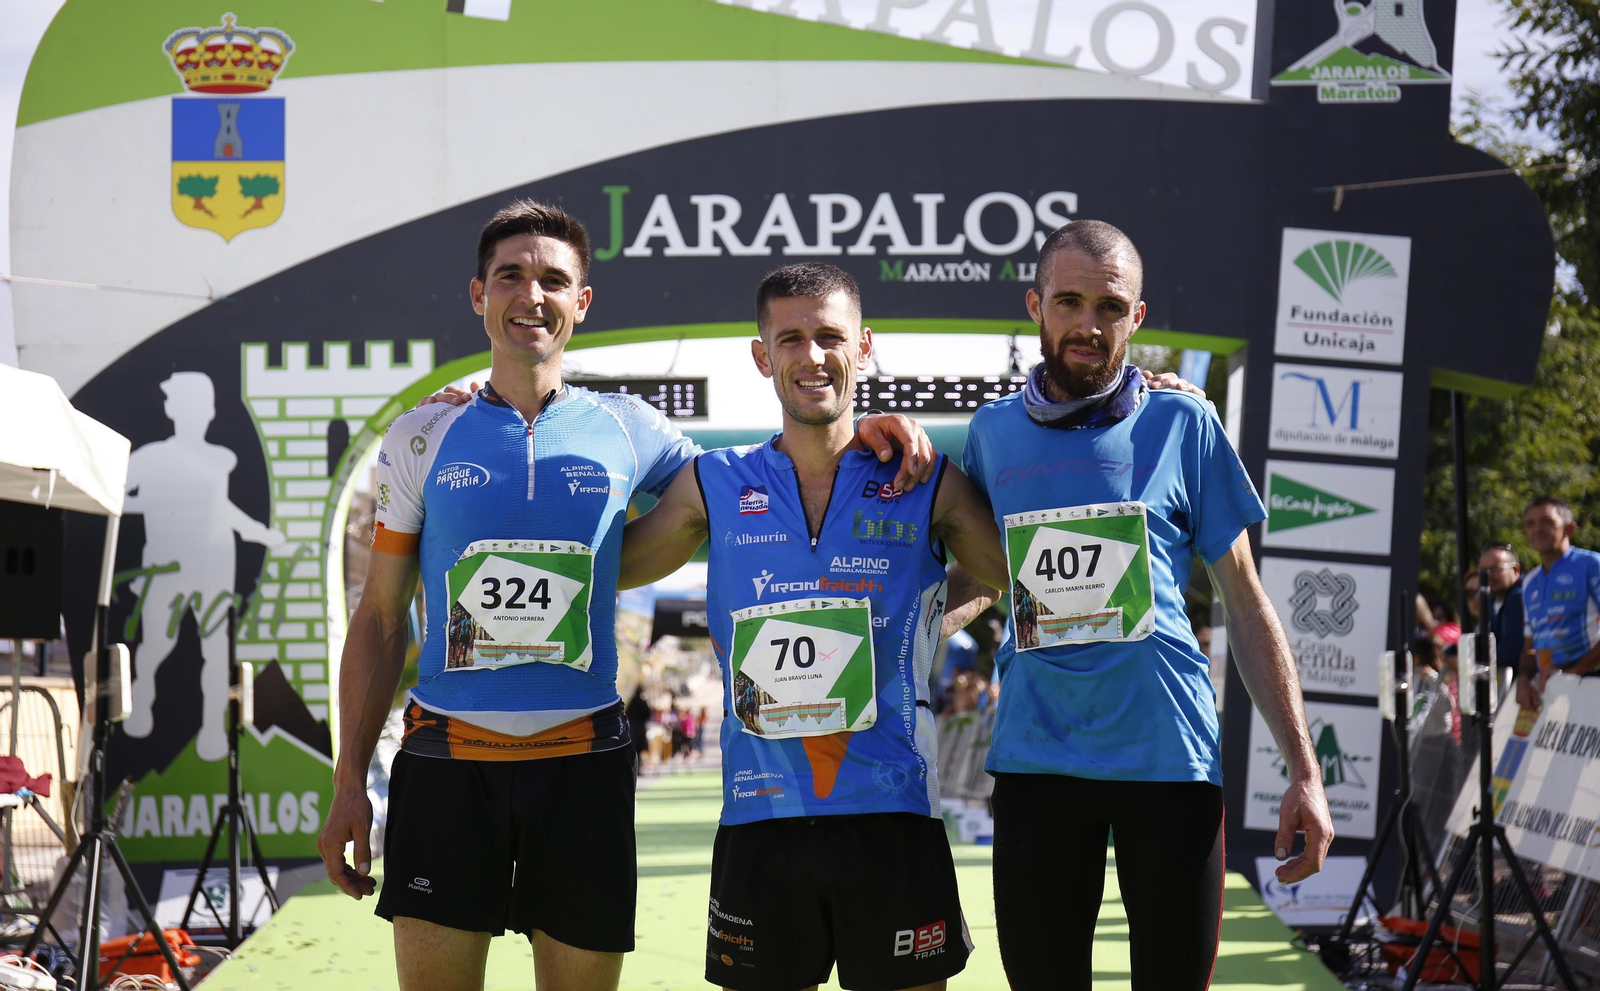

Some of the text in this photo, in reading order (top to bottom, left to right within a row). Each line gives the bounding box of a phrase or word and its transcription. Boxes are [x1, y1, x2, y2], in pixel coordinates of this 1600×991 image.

[1309, 65, 1411, 80] JARAPALOS
[1320, 83, 1398, 100] Maratón
[594, 185, 1078, 262] JARAPALOS
[879, 259, 992, 282] MARATÓN
[1291, 304, 1393, 327] Fundación
[1303, 331, 1375, 354] Unicaja
[1275, 427, 1395, 450] diputación de málaga
[436, 468, 471, 486] PARQUE
[438, 465, 460, 475] AUTOS
[450, 475, 479, 490] FERIA
[734, 531, 787, 546] Alhaurín
[830, 556, 890, 570] ALPINO
[830, 567, 888, 575] BENALMADENA
[1035, 544, 1102, 582] 407
[480, 577, 552, 610] 324
[1065, 585, 1084, 593] MARIN
[1085, 582, 1106, 591] BERRIO
[770, 636, 816, 671] 70
[1295, 647, 1355, 670] enda
[788, 674, 806, 682] BRAVO
[408, 883, 433, 894] Kalenji
[914, 947, 946, 960] TRAIL
